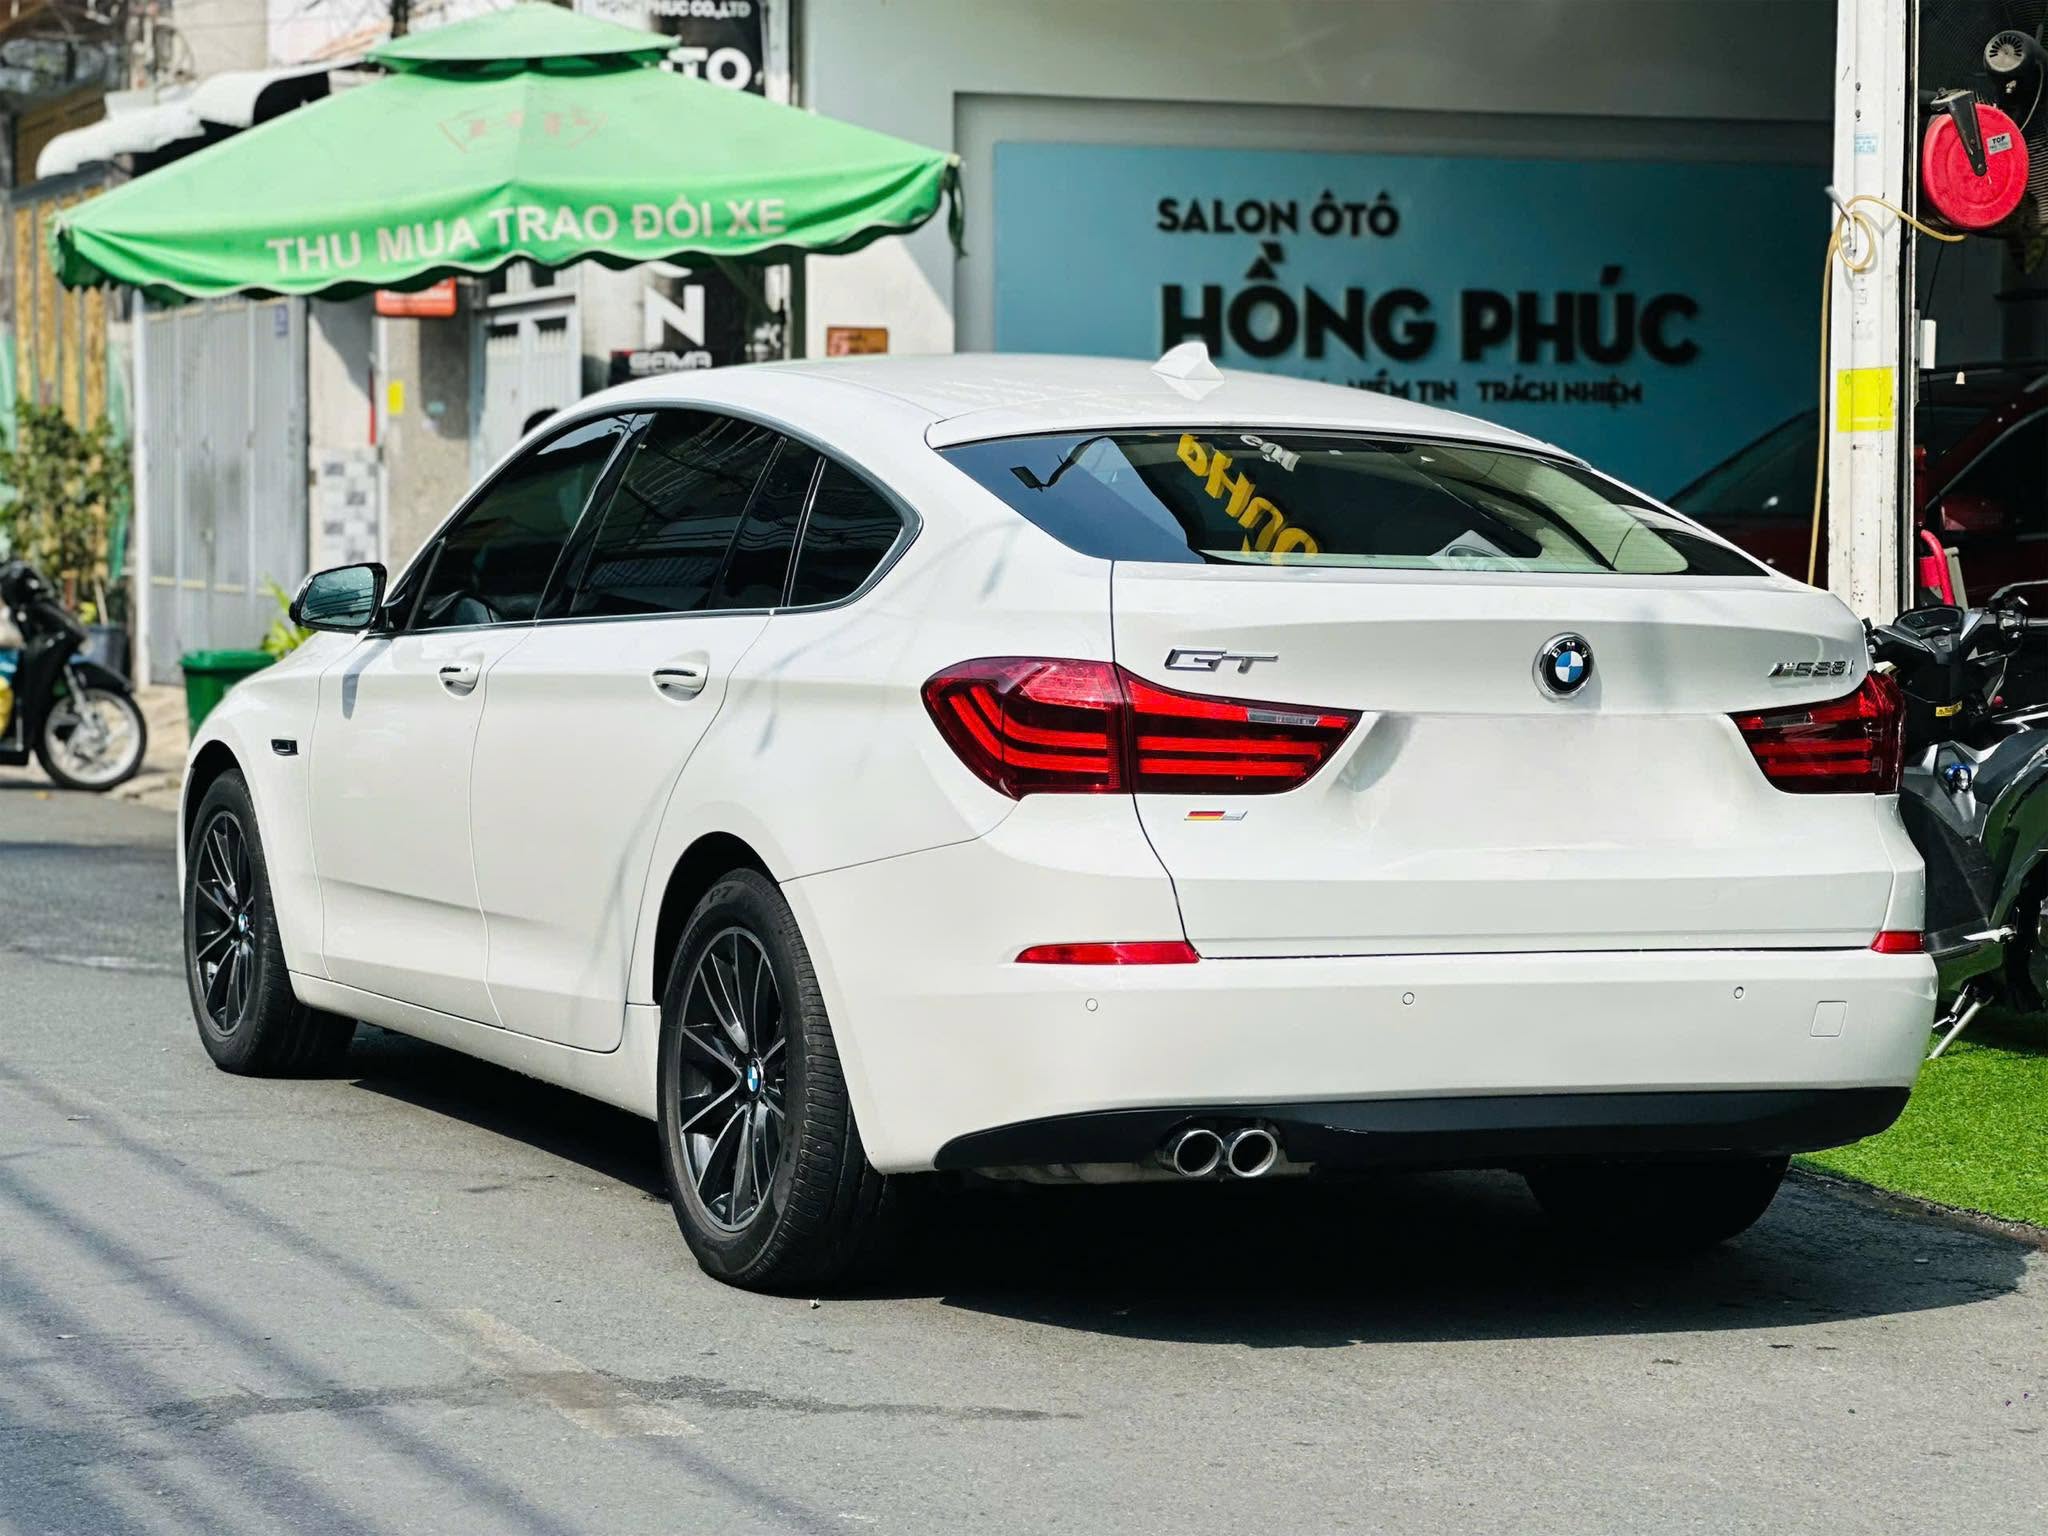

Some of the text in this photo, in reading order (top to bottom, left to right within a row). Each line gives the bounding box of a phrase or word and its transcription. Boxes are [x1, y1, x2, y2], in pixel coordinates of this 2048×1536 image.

[266, 231, 362, 273] THU
[376, 217, 481, 263] MUA
[488, 205, 619, 245] TRAO
[726, 199, 787, 237] XE
[1157, 188, 1400, 237] SALON ÔTÔ
[1161, 241, 1699, 366] HỒNG PHÚC
[1416, 379, 1457, 402] TIN
[1476, 373, 1558, 403] TRÁCH
[1563, 374, 1643, 410] NHIỆM
[1165, 648, 1279, 674] GT
